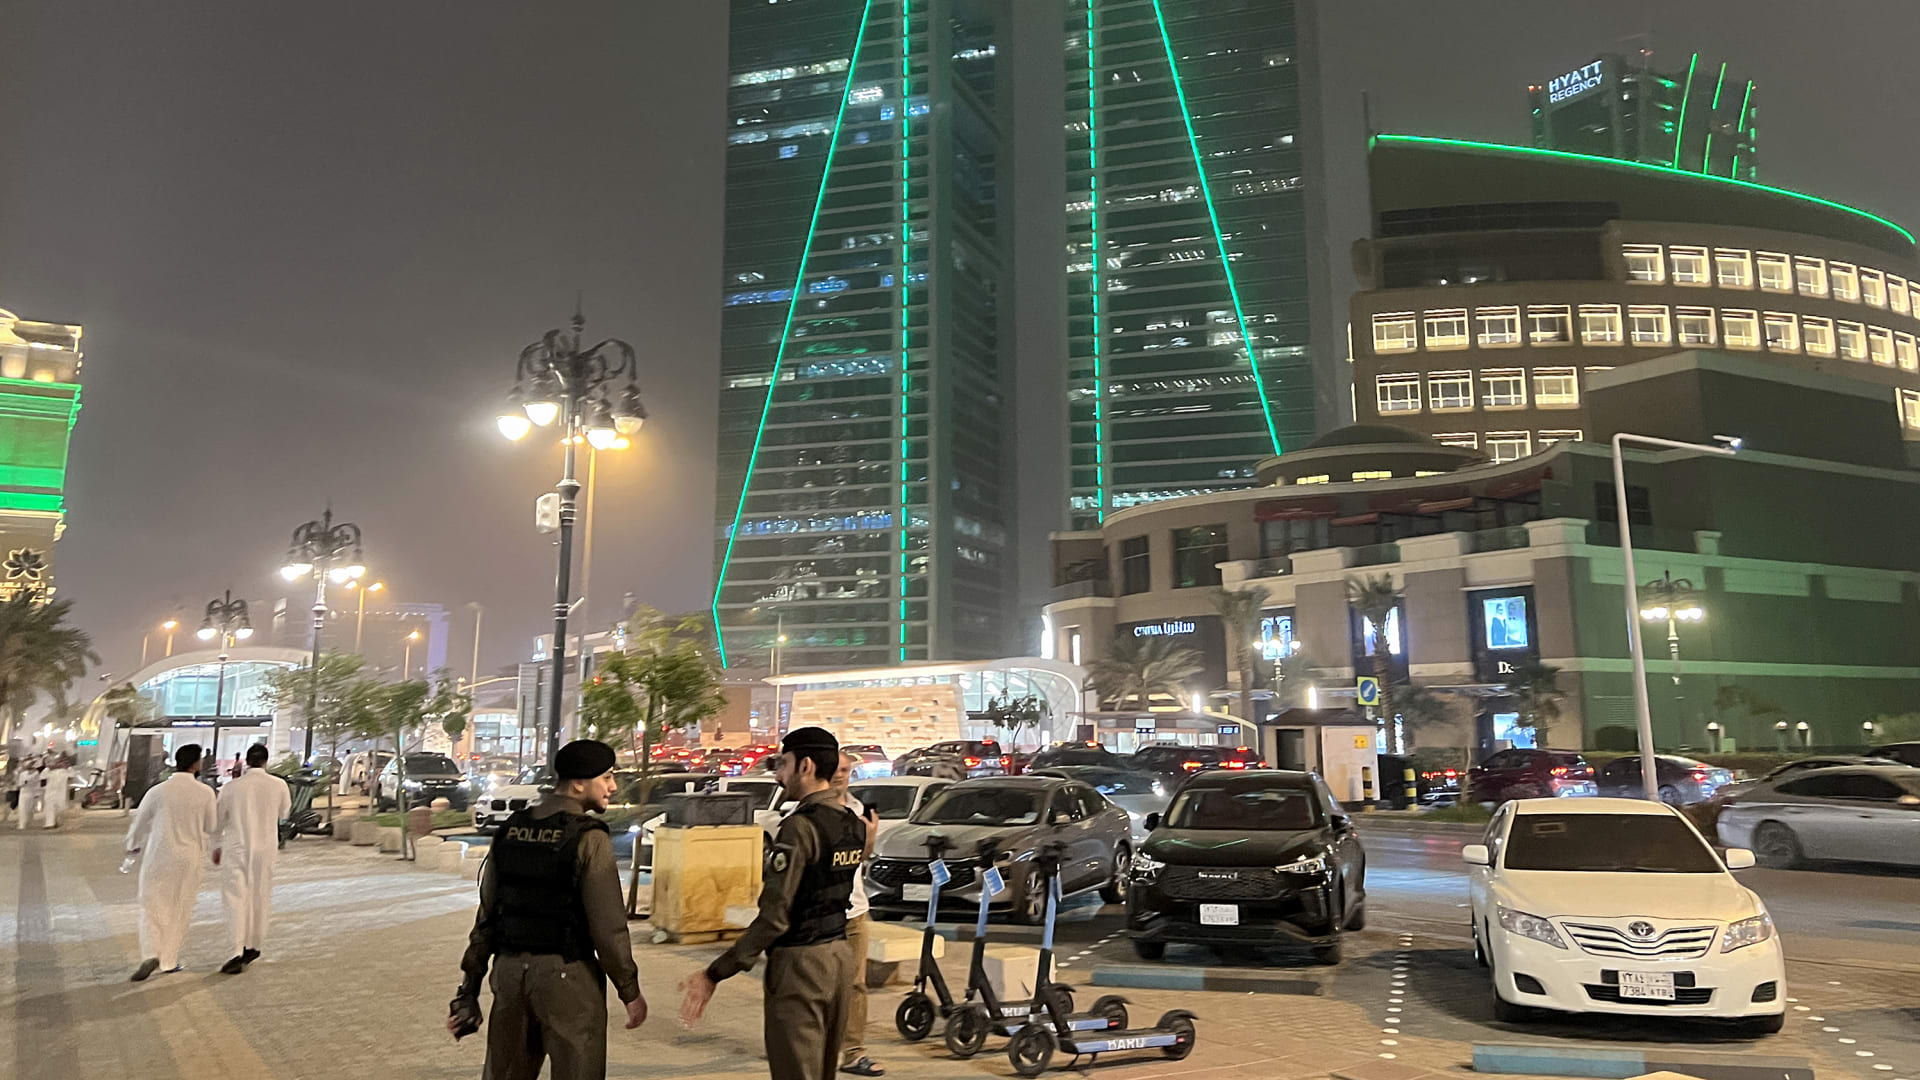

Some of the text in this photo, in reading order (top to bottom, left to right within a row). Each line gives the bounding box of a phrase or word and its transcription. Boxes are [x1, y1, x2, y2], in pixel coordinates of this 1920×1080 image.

[1548, 60, 1603, 93] HYATT
[1549, 73, 1603, 104] REGENCY
[506, 826, 563, 843] POLICE
[832, 849, 863, 867] POLICE
